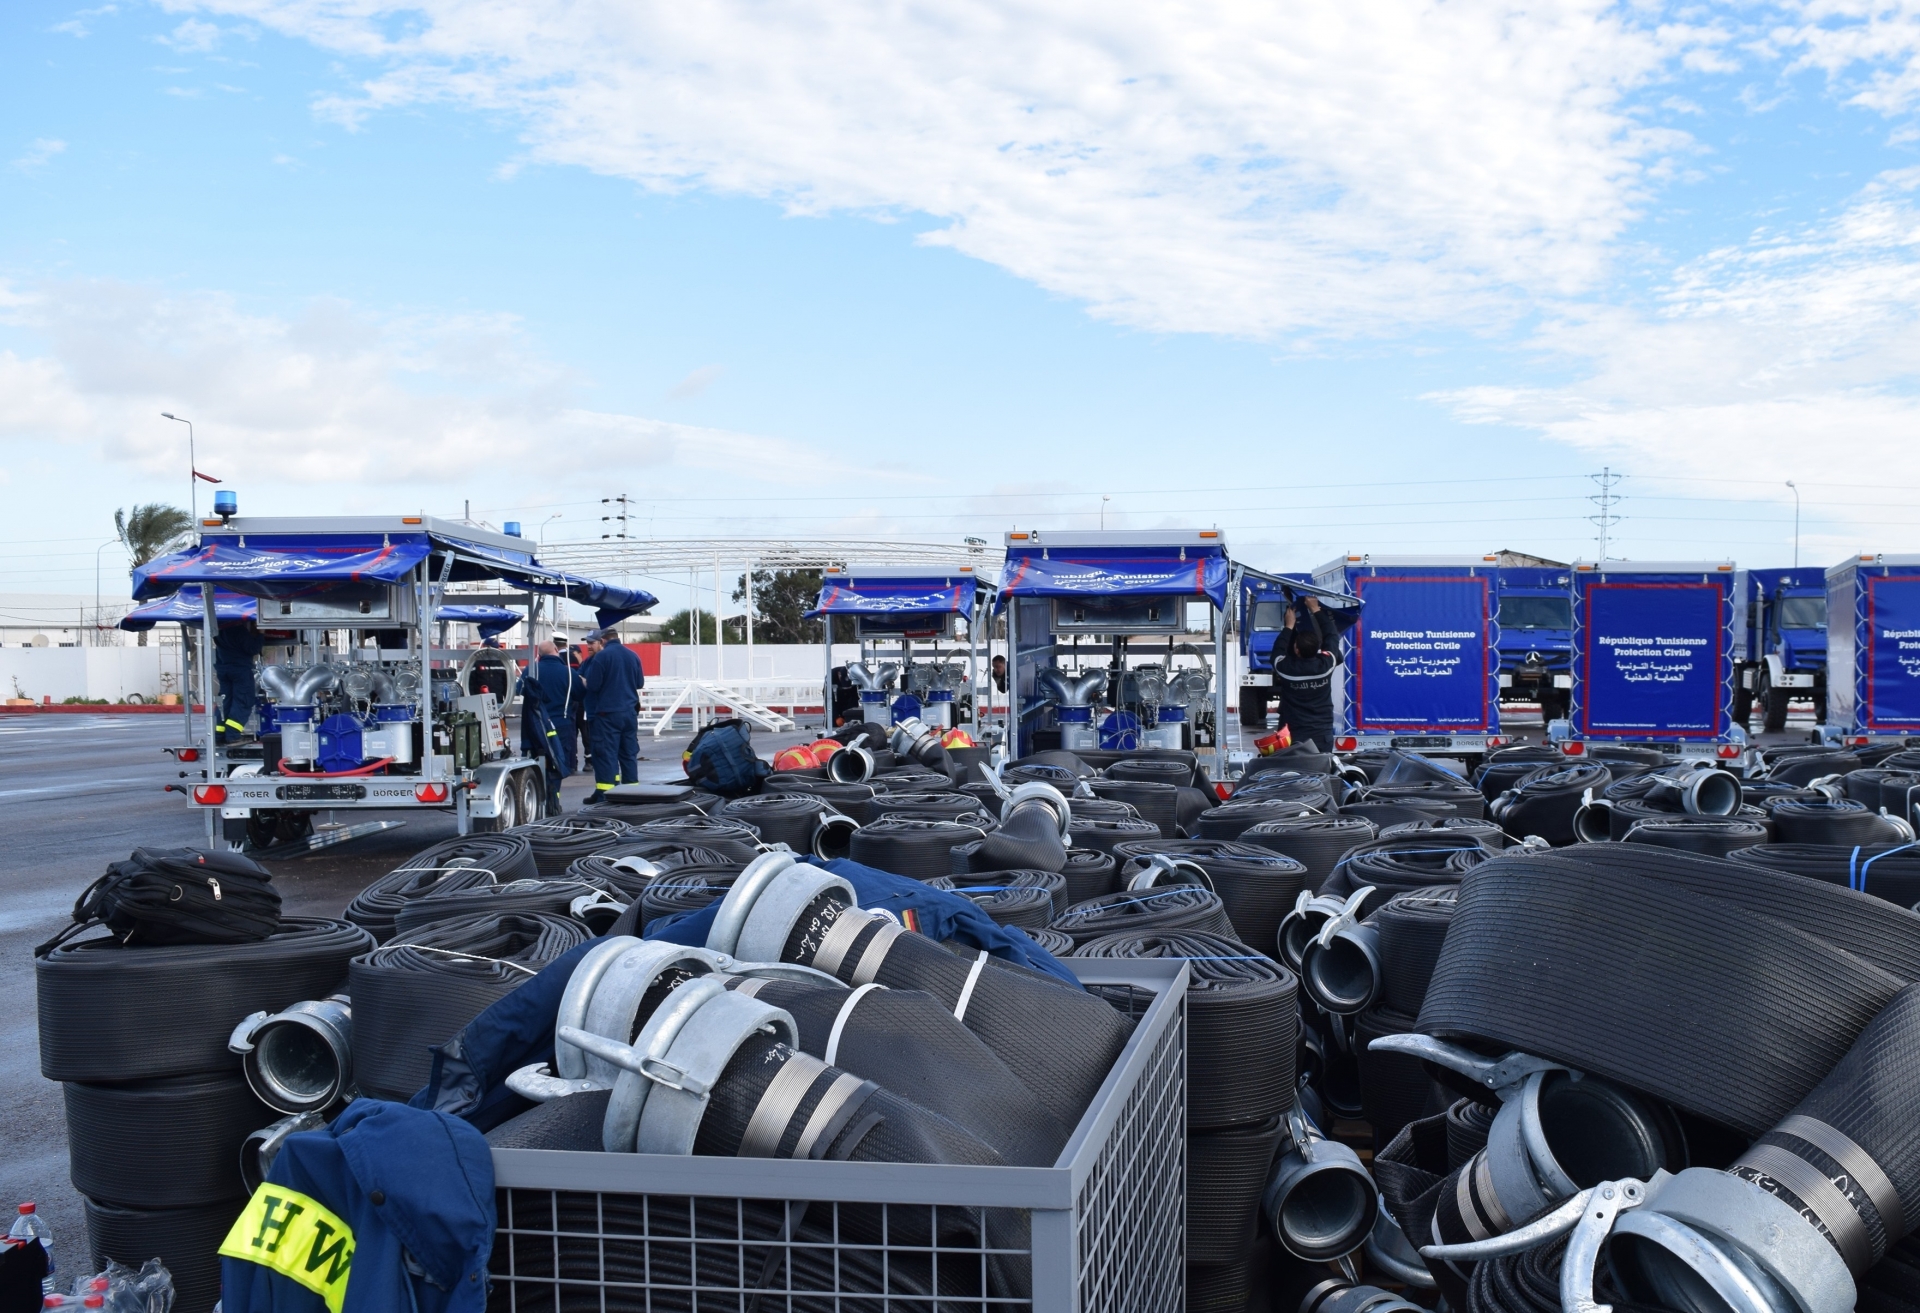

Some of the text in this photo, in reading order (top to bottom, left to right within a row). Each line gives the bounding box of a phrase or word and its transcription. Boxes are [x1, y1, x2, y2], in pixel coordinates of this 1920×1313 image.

[1371, 630, 1476, 640] République Tunisienne
[1599, 636, 1707, 646] République Tunisienne
[1386, 642, 1461, 650] Protection Civile
[1614, 648, 1692, 657] Protection Civile
[373, 788, 413, 797] BÖRGER
